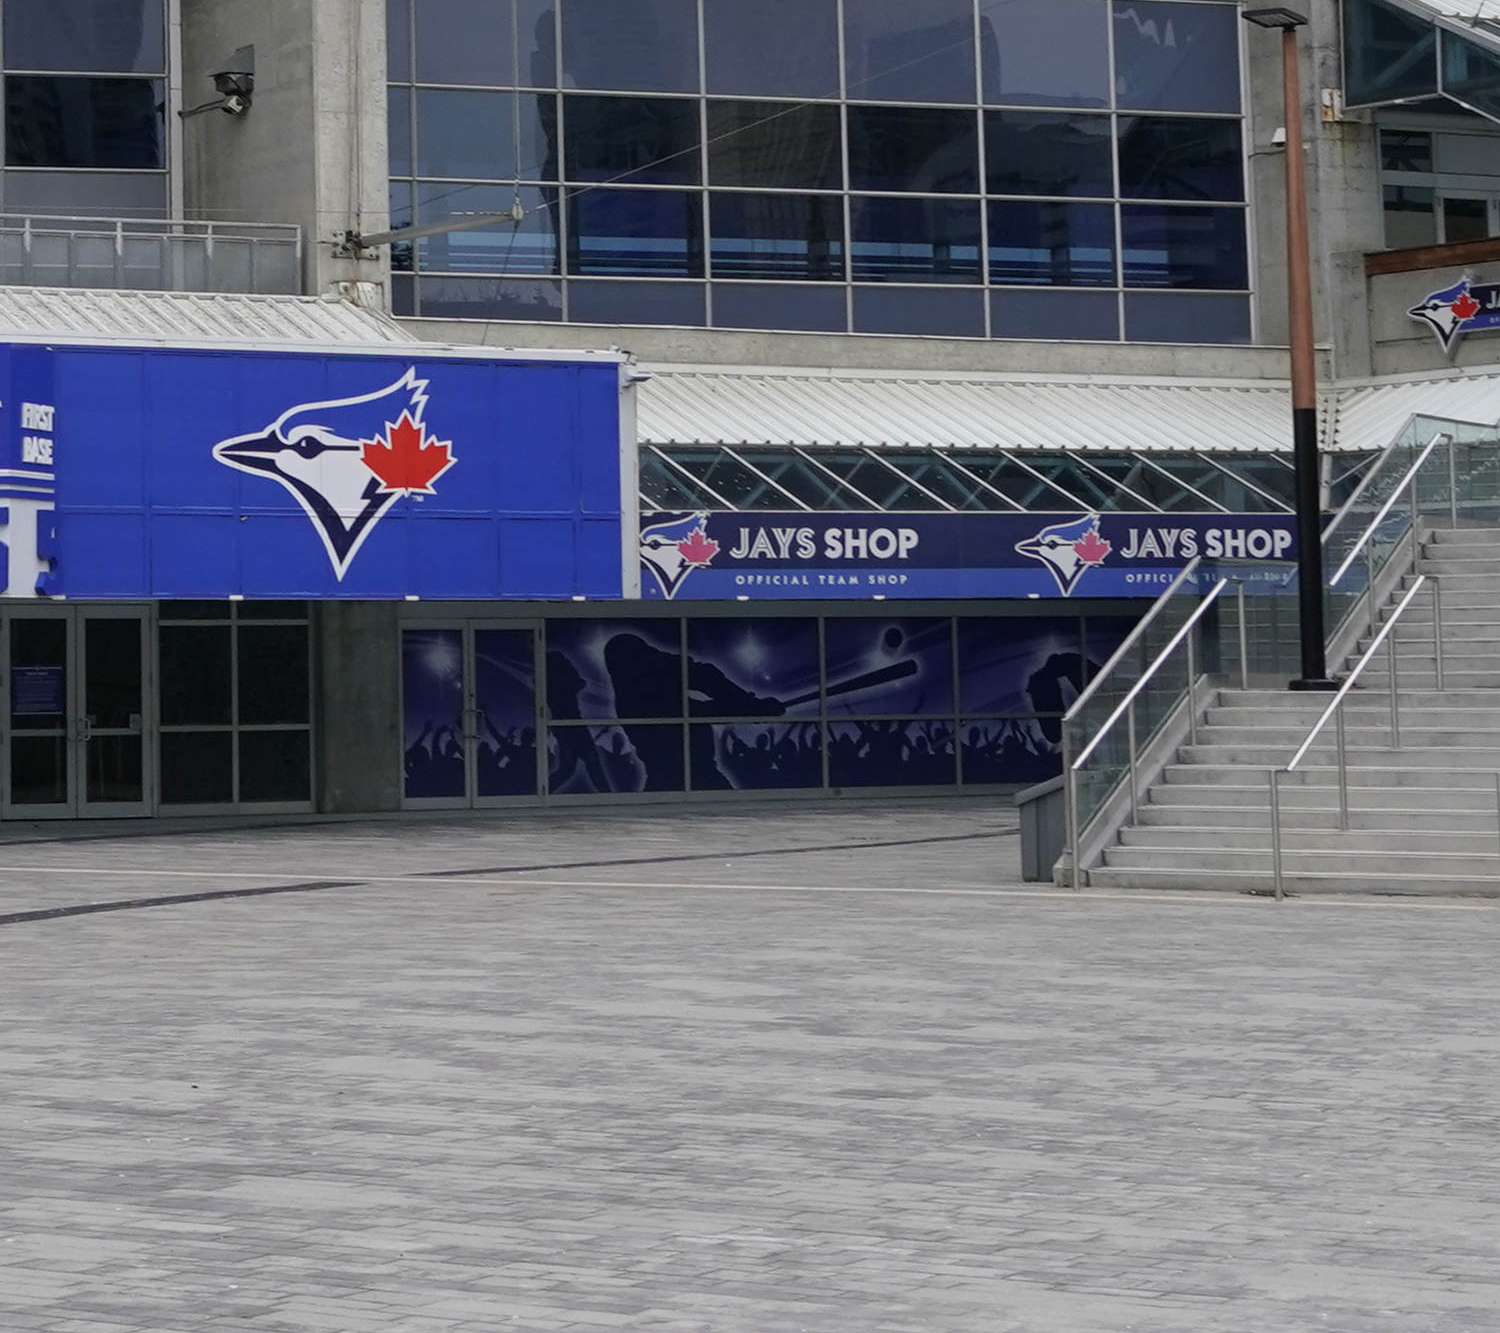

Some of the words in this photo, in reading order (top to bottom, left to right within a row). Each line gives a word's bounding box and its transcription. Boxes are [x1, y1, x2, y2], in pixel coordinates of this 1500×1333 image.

[21, 402, 55, 431] FIRST
[22, 436, 54, 465] BASE
[729, 527, 816, 559] JAYS
[824, 527, 919, 559] SHOP
[1120, 527, 1199, 559] JAYS
[1204, 528, 1293, 559] SHOP
[735, 574, 809, 586] OFFICIAL
[818, 574, 860, 585] TEAM
[868, 574, 908, 585] SHOP
